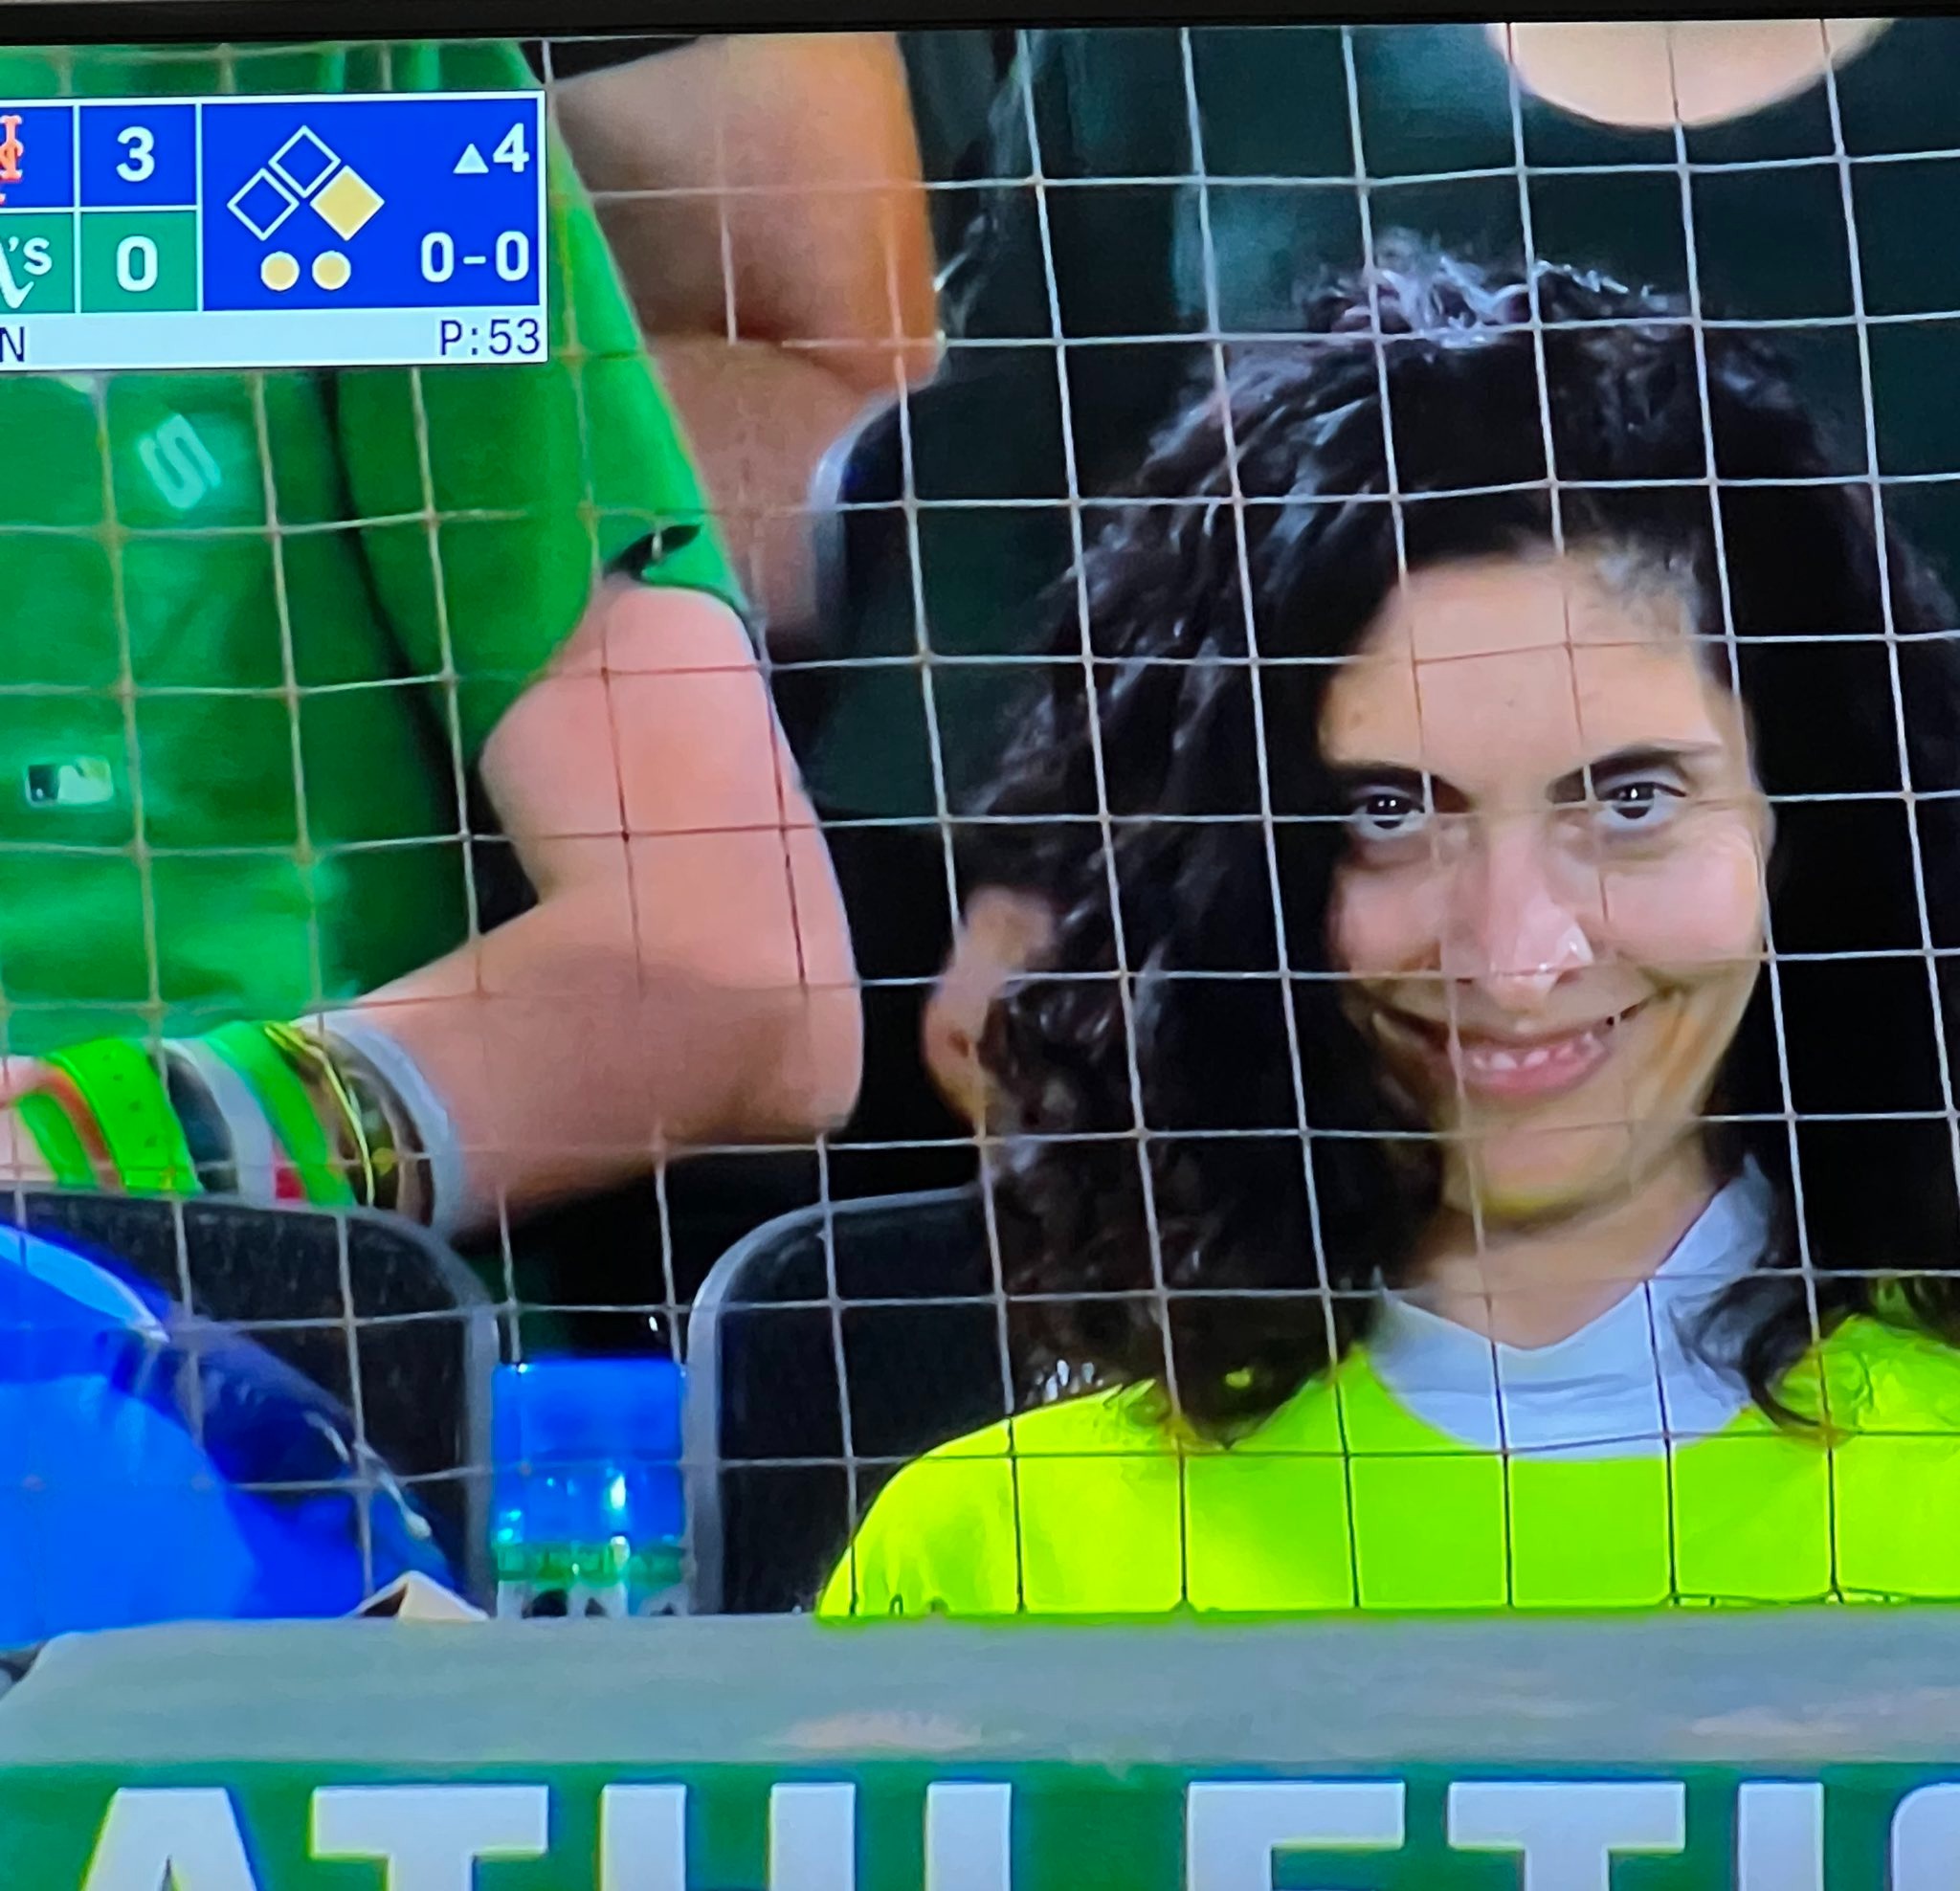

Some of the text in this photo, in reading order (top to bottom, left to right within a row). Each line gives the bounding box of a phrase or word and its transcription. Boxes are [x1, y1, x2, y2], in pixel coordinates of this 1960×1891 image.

[116, 125, 155, 183] 3
[493, 122, 529, 173] 4
[116, 235, 158, 292] 0
[421, 231, 529, 282] 0-0
[439, 318, 540, 356] P:53
